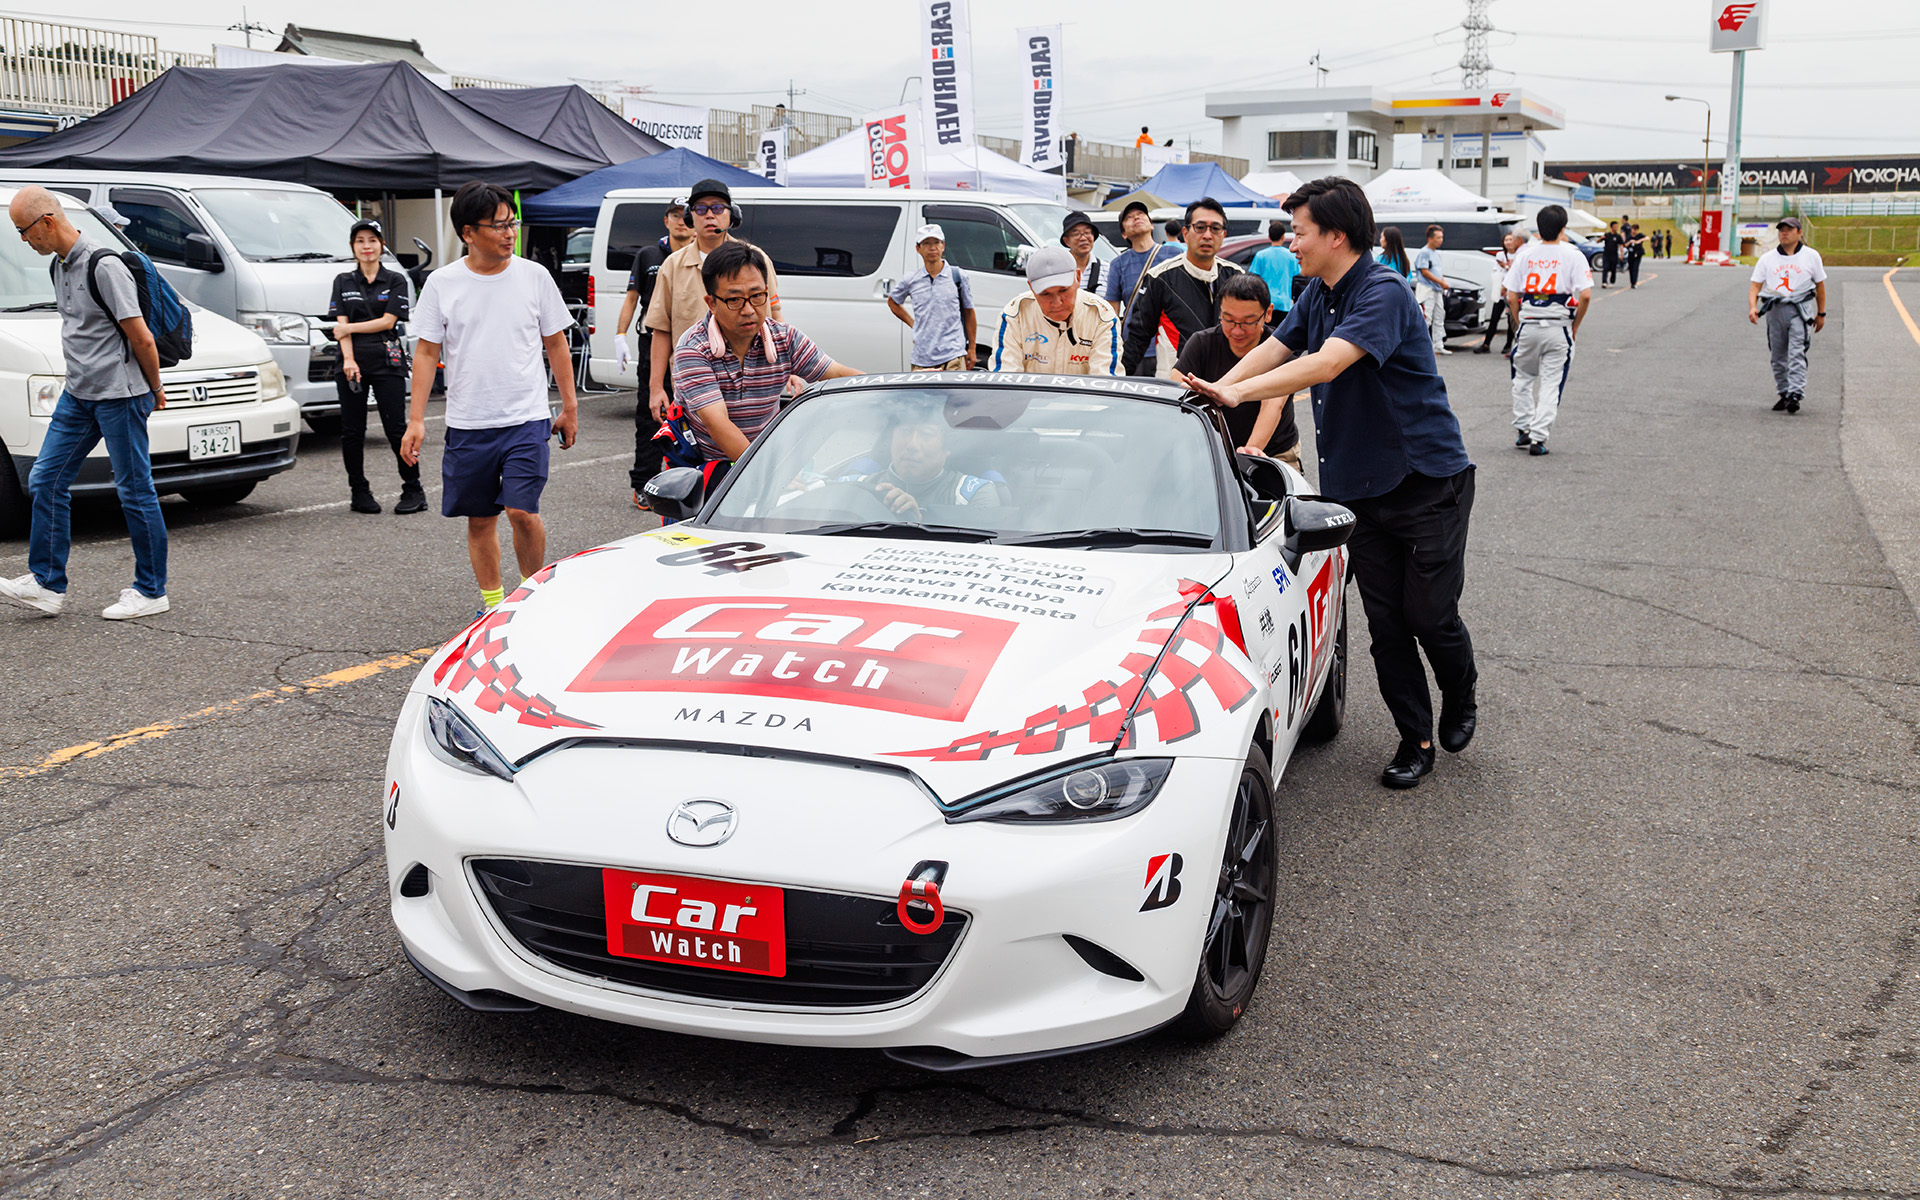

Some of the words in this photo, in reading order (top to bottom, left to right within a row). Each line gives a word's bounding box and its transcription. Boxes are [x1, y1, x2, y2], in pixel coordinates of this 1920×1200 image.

[1588, 171, 1675, 187] YOKOHAMA
[1525, 273, 1557, 294] 84
[844, 372, 943, 387] MAZDA
[953, 372, 1042, 384] SPIRIT
[1051, 377, 1161, 396] RACING
[201, 436, 236, 456] 34-21
[1325, 513, 1354, 527] KTEL
[656, 542, 811, 577] 64
[863, 554, 979, 569] Ishikawa
[987, 563, 1084, 581] Kazuya
[872, 547, 999, 562] Kusakabe
[1010, 557, 1087, 572] Yasuo
[835, 571, 956, 588] Ishikawa
[967, 582, 1065, 604] Takuya
[850, 562, 991, 579] Kobayashi
[1001, 575, 1105, 596] Takashi
[821, 582, 969, 603] Kawakami
[975, 596, 1077, 620] Kanata
[652, 603, 964, 651] Car
[671, 647, 890, 690] Watch
[673, 707, 813, 732] MAZDA
[631, 884, 758, 934] Car
[651, 930, 741, 963] Watch
